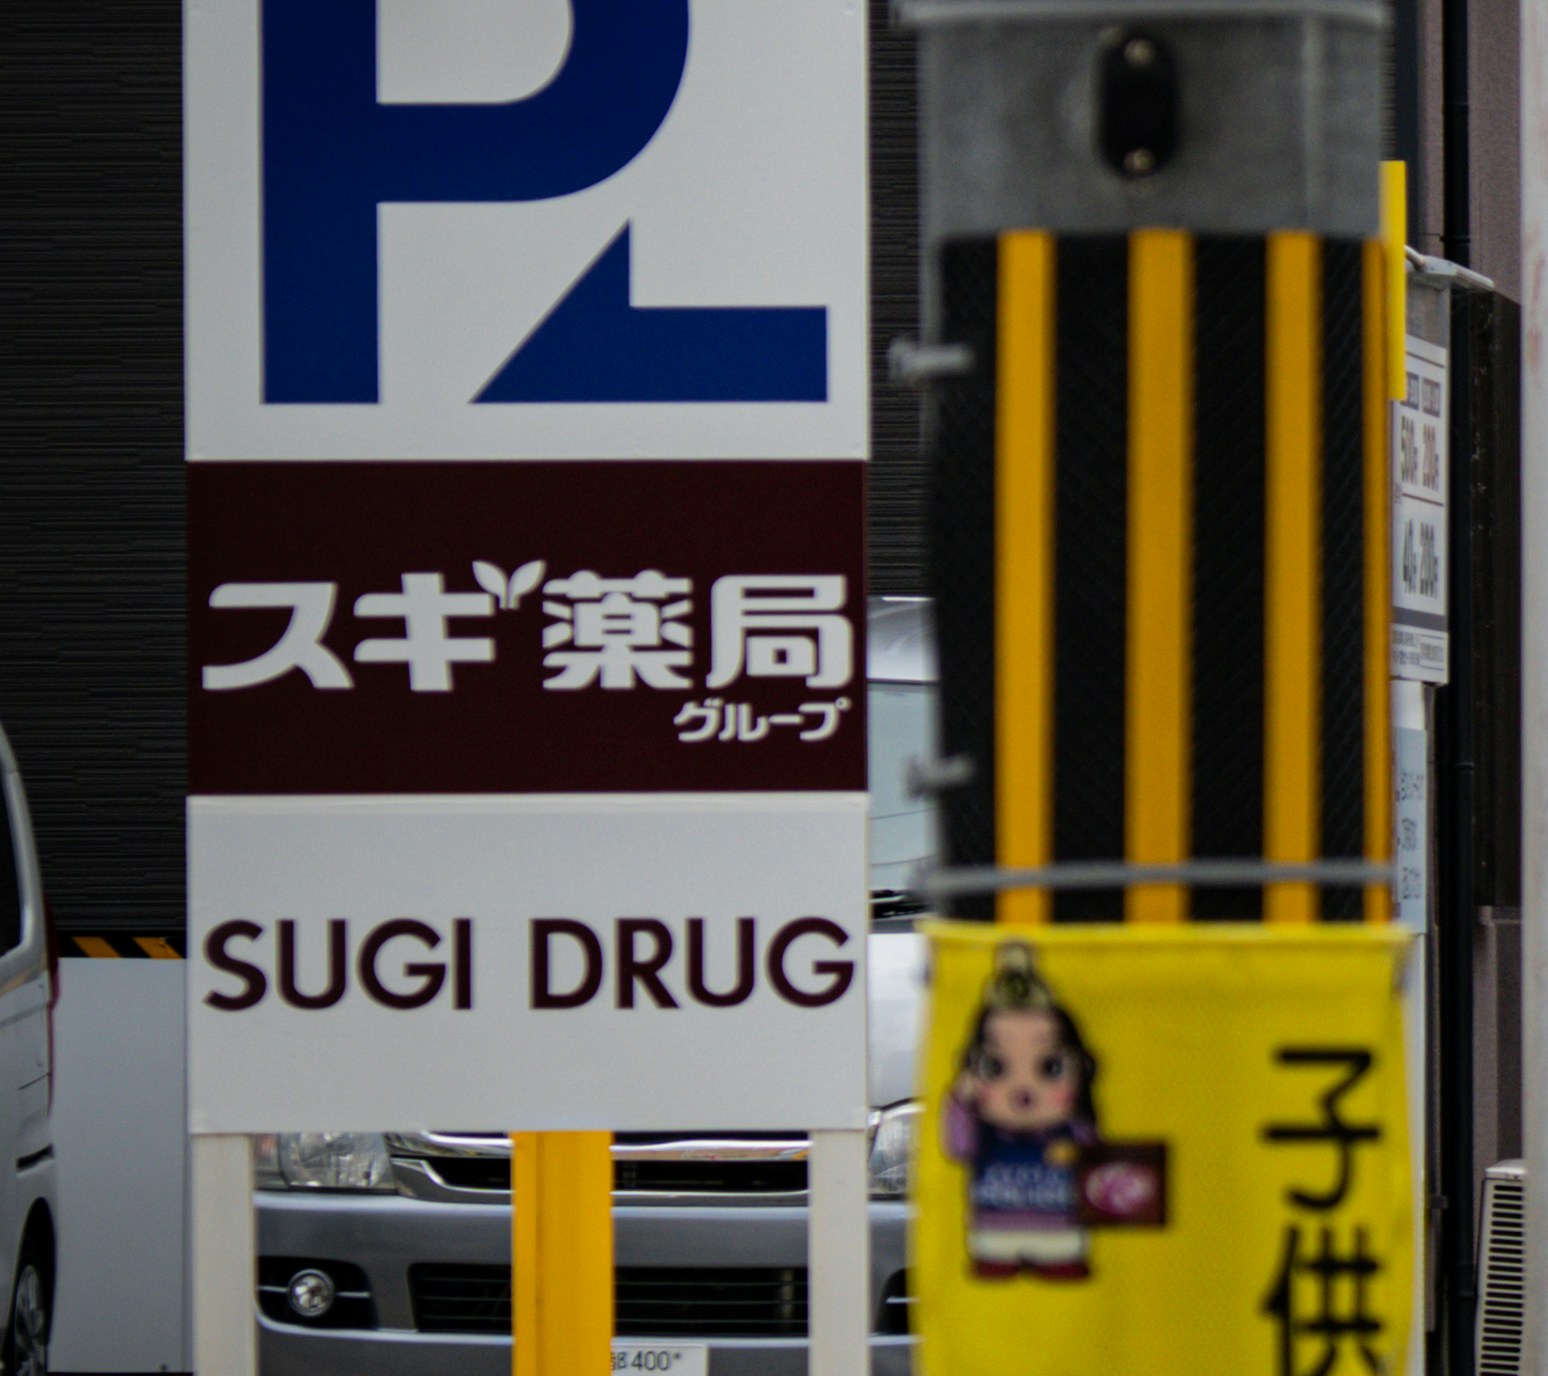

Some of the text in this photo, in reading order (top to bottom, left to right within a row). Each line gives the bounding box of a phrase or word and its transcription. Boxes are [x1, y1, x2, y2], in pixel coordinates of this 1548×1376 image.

[202, 557, 854, 692] スギ薬局
[674, 696, 852, 744] グループ
[202, 916, 856, 1014] SUGI DRUG
